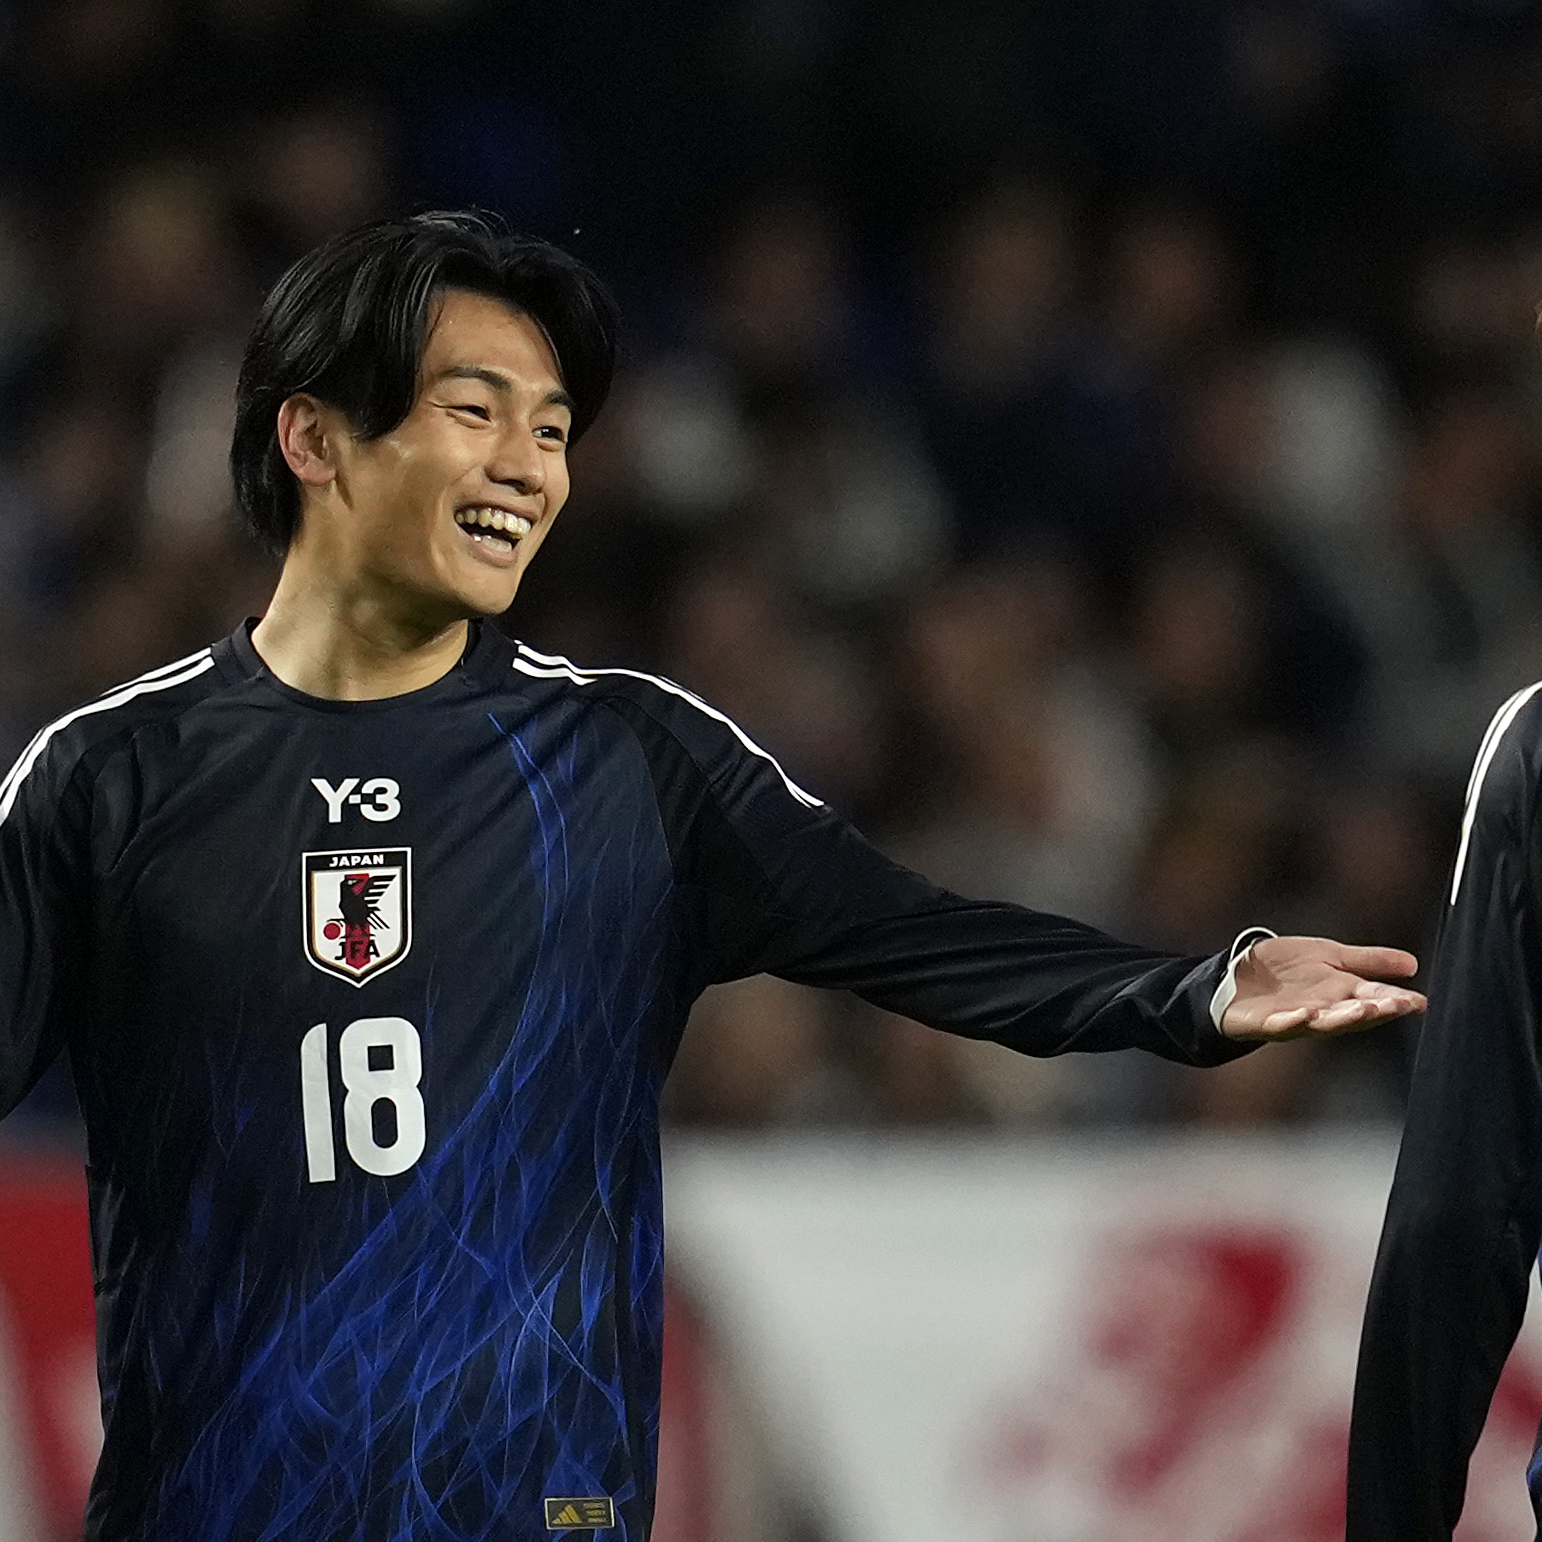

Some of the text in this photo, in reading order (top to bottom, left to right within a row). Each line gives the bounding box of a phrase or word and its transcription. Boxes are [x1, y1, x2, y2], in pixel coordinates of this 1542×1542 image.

[310, 777, 402, 824] Y-3
[328, 853, 385, 868] JAPAN
[333, 939, 381, 962] JFA
[300, 1016, 427, 1184] 18
